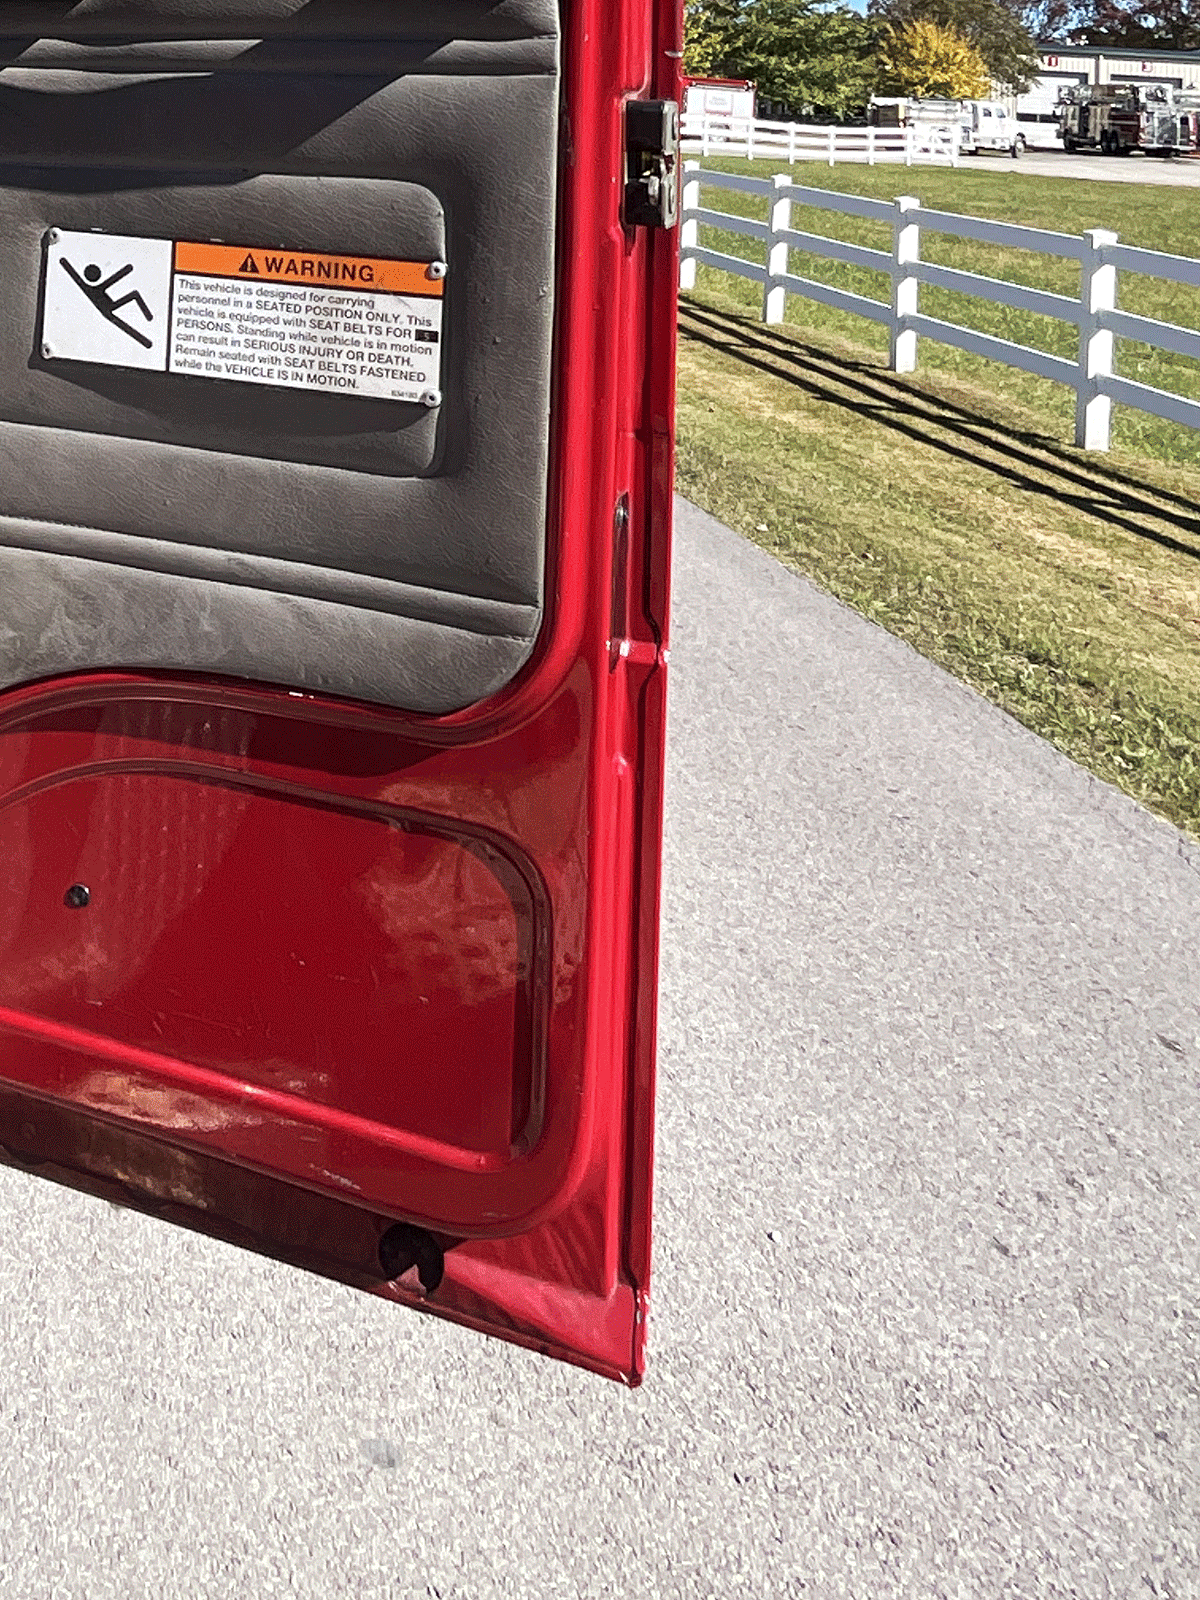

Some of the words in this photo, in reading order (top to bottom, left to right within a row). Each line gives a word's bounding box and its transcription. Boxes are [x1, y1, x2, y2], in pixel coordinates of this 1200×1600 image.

[264, 255, 374, 283] WARNING
[177, 294, 231, 306] personnel
[233, 300, 243, 308] in
[245, 300, 253, 309] a
[255, 299, 302, 314] SEATED
[304, 304, 363, 321] POSITION
[365, 310, 404, 324] ONLY.
[406, 314, 432, 328] This
[178, 278, 202, 291] This
[203, 282, 242, 295] vehicle
[243, 287, 254, 296] is
[255, 287, 307, 302] designed
[309, 291, 325, 303] for
[327, 295, 375, 310] carrying
[176, 317, 234, 334] PERSONS.
[237, 324, 286, 341] Standing
[288, 330, 318, 343] while
[320, 334, 362, 348] vehicle
[363, 338, 374, 349] is
[376, 339, 388, 351] in
[390, 343, 433, 356] motion
[177, 306, 215, 319] vehicle
[217, 311, 227, 319] is
[228, 312, 280, 326] equipped
[282, 317, 307, 328] with
[308, 317, 341, 332] SEAT
[343, 321, 383, 336] BELTS
[385, 326, 412, 340] FOR
[175, 332, 196, 342] can
[198, 335, 229, 346] result
[230, 339, 241, 348] in
[243, 338, 297, 354] SERIOUS
[298, 344, 344, 359] INJURY
[345, 349, 365, 362] OR
[367, 352, 414, 368] DEATH.
[175, 344, 216, 358] Remain
[218, 351, 256, 363] seated
[257, 354, 282, 366] with
[284, 356, 316, 370] SEAT
[317, 360, 357, 375] BELTS
[359, 365, 427, 383] FASTENED
[174, 358, 203, 370] while
[205, 361, 222, 373] the
[224, 363, 274, 379] VEHICLE
[277, 369, 289, 381] IS
[291, 371, 304, 383] IN
[306, 373, 360, 389] MOTION.
